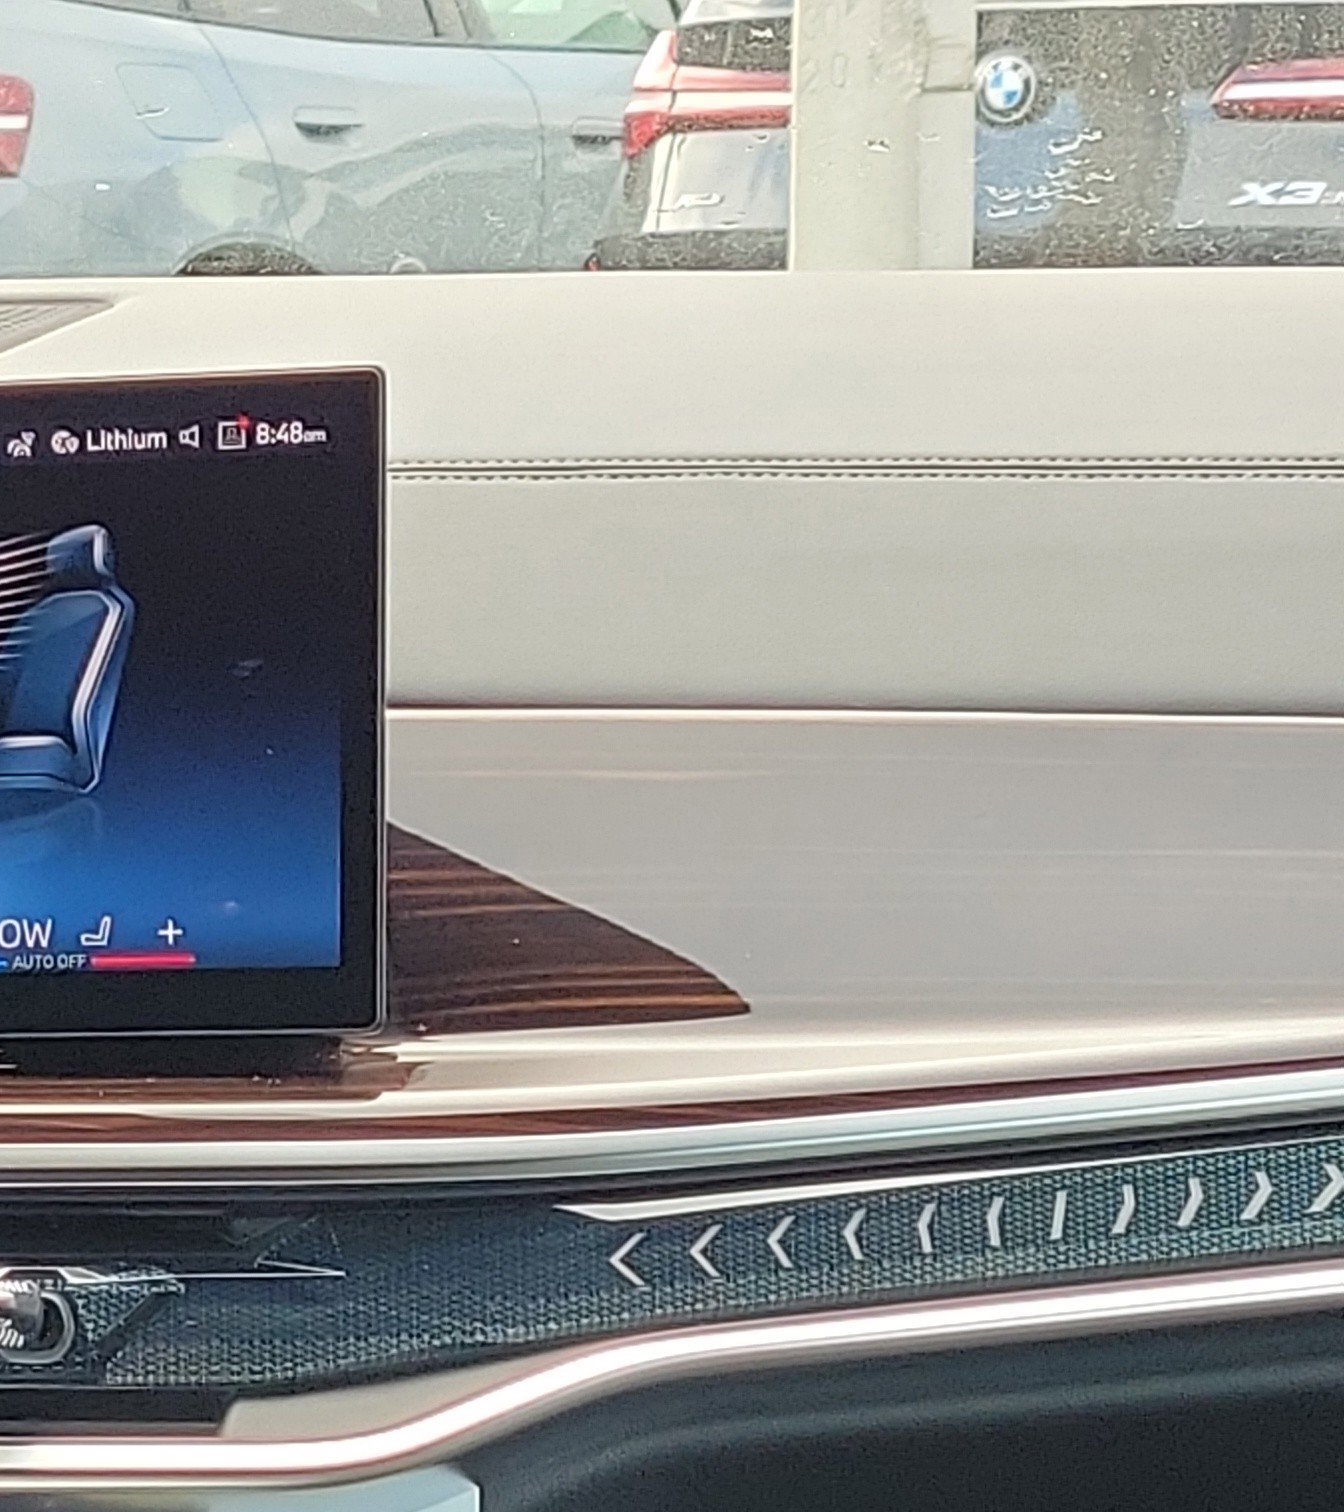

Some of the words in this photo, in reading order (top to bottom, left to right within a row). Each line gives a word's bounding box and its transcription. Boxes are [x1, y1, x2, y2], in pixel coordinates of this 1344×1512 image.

[86, 428, 168, 451] Lithium
[12, 954, 55, 971] AUTO
[57, 953, 88, 970] OFF
